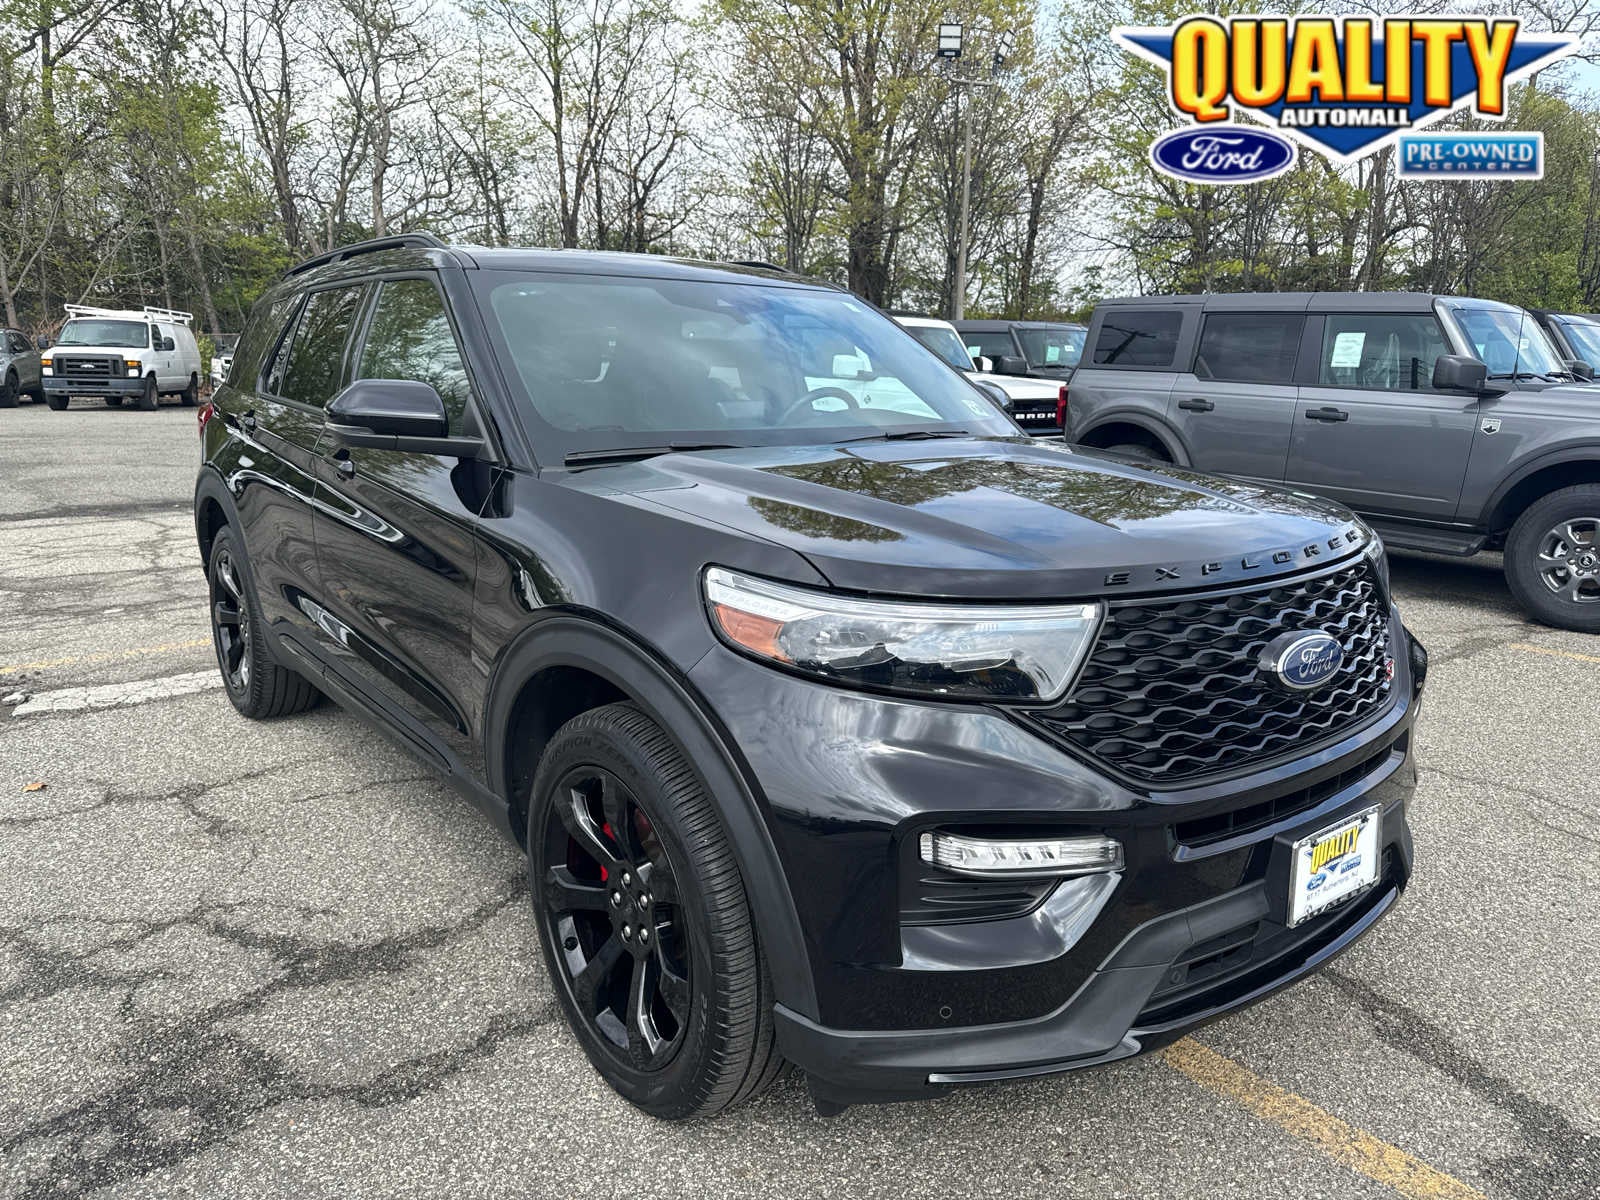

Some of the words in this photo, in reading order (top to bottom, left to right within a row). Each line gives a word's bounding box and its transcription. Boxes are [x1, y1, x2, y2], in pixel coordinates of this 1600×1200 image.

[1015, 412, 1056, 420] BRON
[1103, 529, 1360, 587] EXPLORER
[1298, 645, 1334, 679] Ford
[1310, 825, 1360, 875] QUALITY
